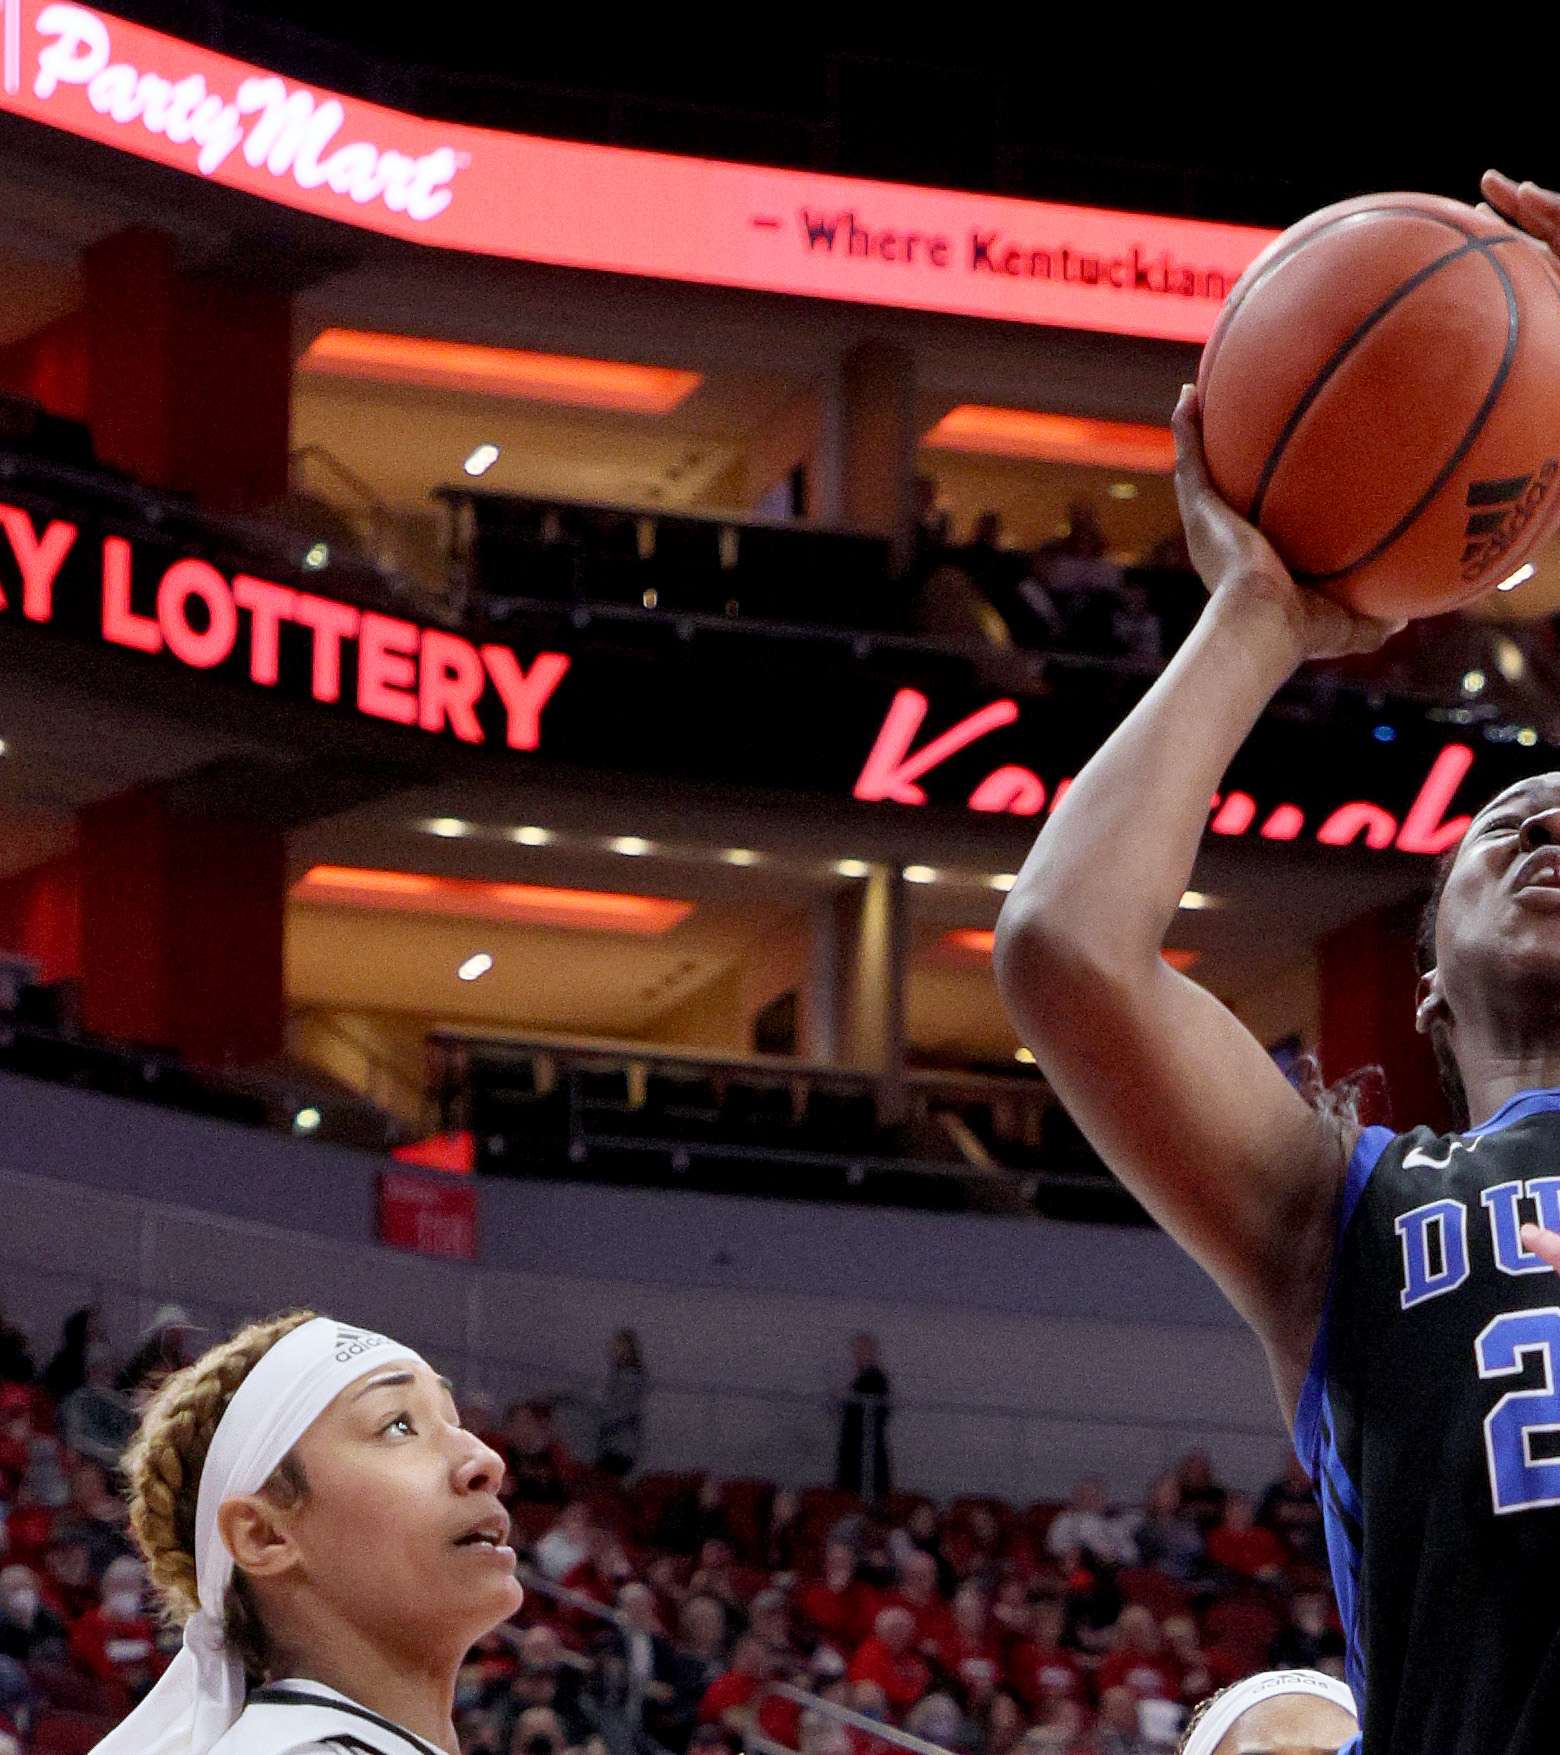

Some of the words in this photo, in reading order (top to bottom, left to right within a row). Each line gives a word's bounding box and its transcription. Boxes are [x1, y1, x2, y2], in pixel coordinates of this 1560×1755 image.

[34, 3, 460, 222] PartyMart
[803, 208, 949, 267] Where
[0, 504, 78, 623] Y
[102, 534, 571, 751] LOTTERY
